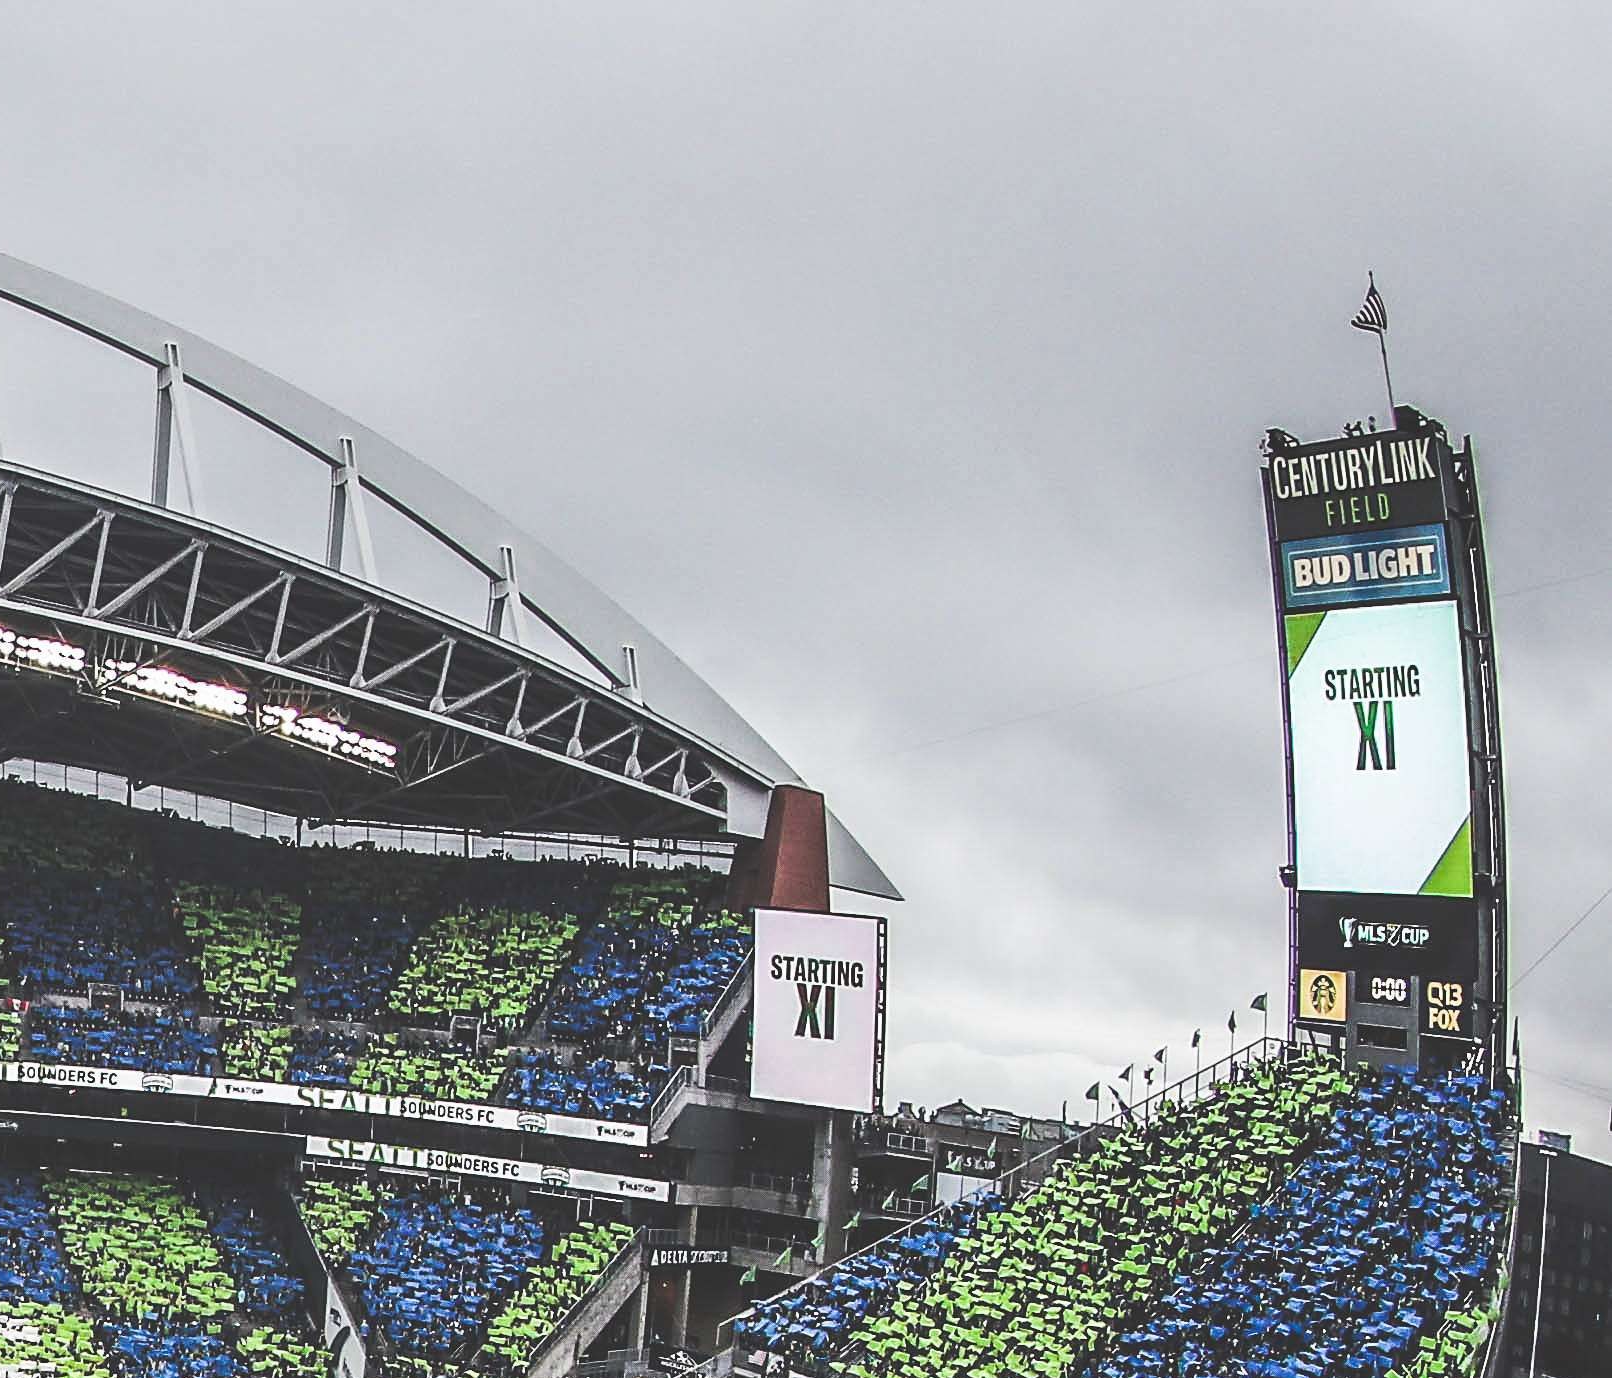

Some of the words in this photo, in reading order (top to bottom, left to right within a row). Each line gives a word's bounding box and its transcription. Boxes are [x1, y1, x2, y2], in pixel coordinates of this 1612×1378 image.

[1273, 437, 1436, 499] CENTURYLINK
[1326, 493, 1390, 526] FIELD
[1294, 554, 1350, 587] BUD
[1354, 545, 1436, 580] LIGHT
[1325, 664, 1420, 701] STARTING
[1353, 701, 1396, 770] XI
[1358, 924, 1386, 943] MLS
[1401, 926, 1429, 945] CUP
[771, 954, 863, 988] STARTING
[1371, 977, 1406, 1001] 0:00
[1428, 982, 1462, 1006] Q13
[794, 983, 835, 1039] XI
[1429, 1008, 1460, 1031] FOX
[100, 1072, 118, 1086] FC
[477, 1107, 494, 1123] FC
[503, 1162, 520, 1177] FC
